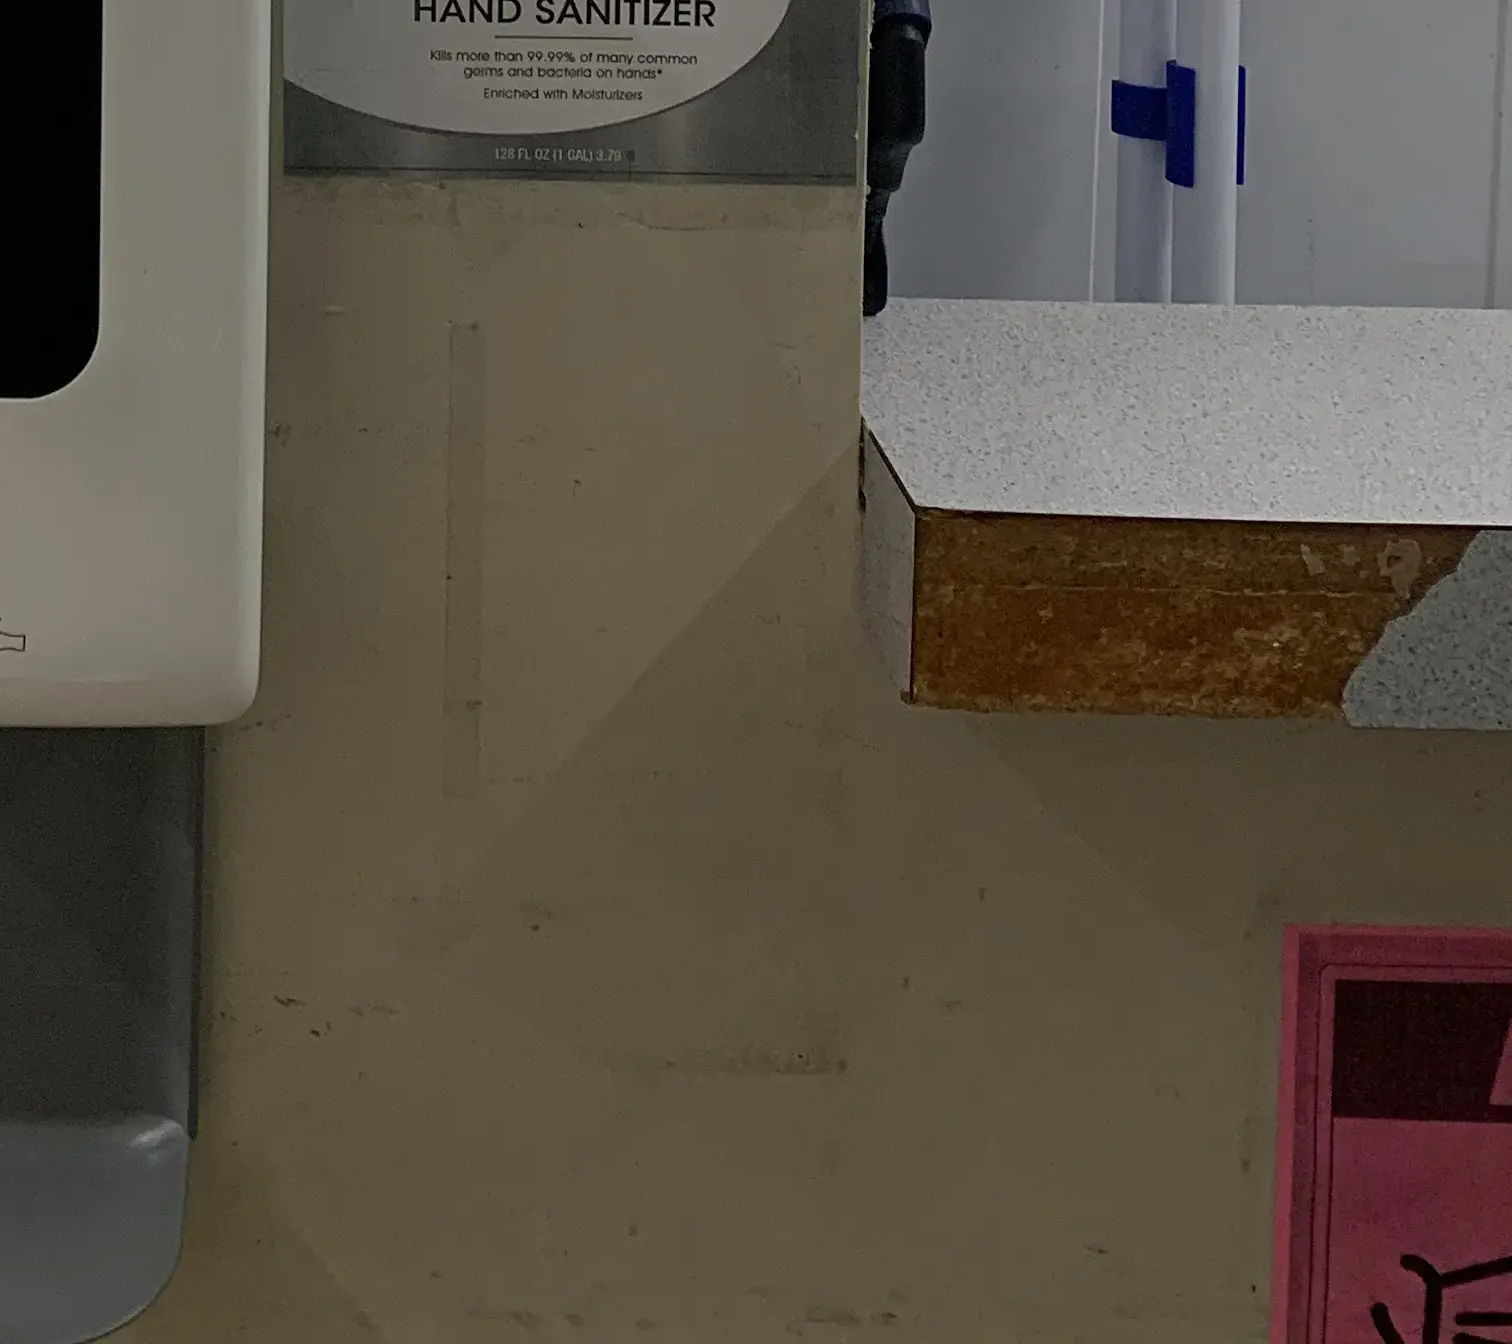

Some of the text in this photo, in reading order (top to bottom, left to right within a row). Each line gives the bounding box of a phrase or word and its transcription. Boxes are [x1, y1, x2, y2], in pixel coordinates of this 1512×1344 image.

[430, 49, 698, 65] Kills more than 99.99% of many common
[463, 67, 504, 79] germs
[508, 66, 533, 77] and
[538, 67, 592, 78] bacteria
[596, 69, 613, 78] on
[484, 88, 643, 101] Enriched with Moisturizers
[494, 148, 622, 161] 128 FL OZ (1 GAL) 3.79
